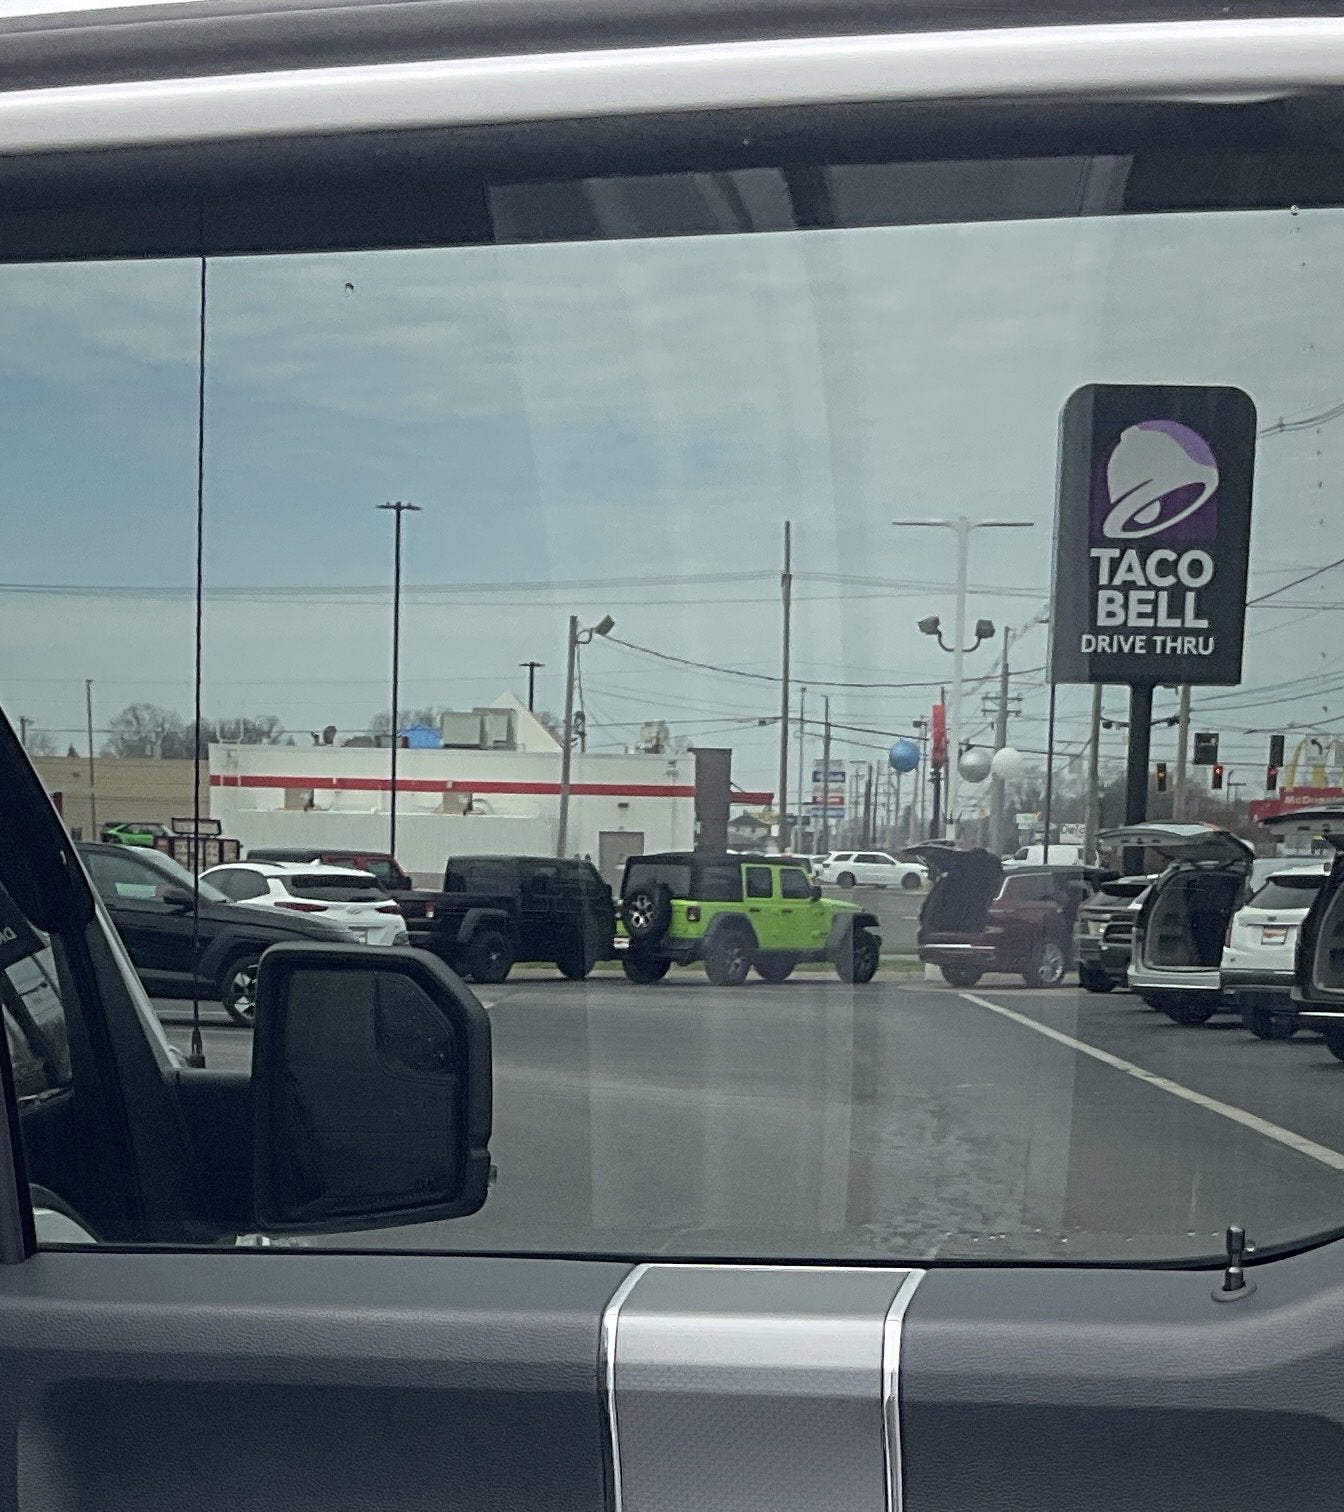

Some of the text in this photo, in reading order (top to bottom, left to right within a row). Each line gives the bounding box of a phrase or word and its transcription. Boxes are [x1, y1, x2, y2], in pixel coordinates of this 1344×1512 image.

[1090, 548, 1214, 588] TACO
[1097, 590, 1208, 629] BELL
[1081, 634, 1215, 656] DRIVE THRU
